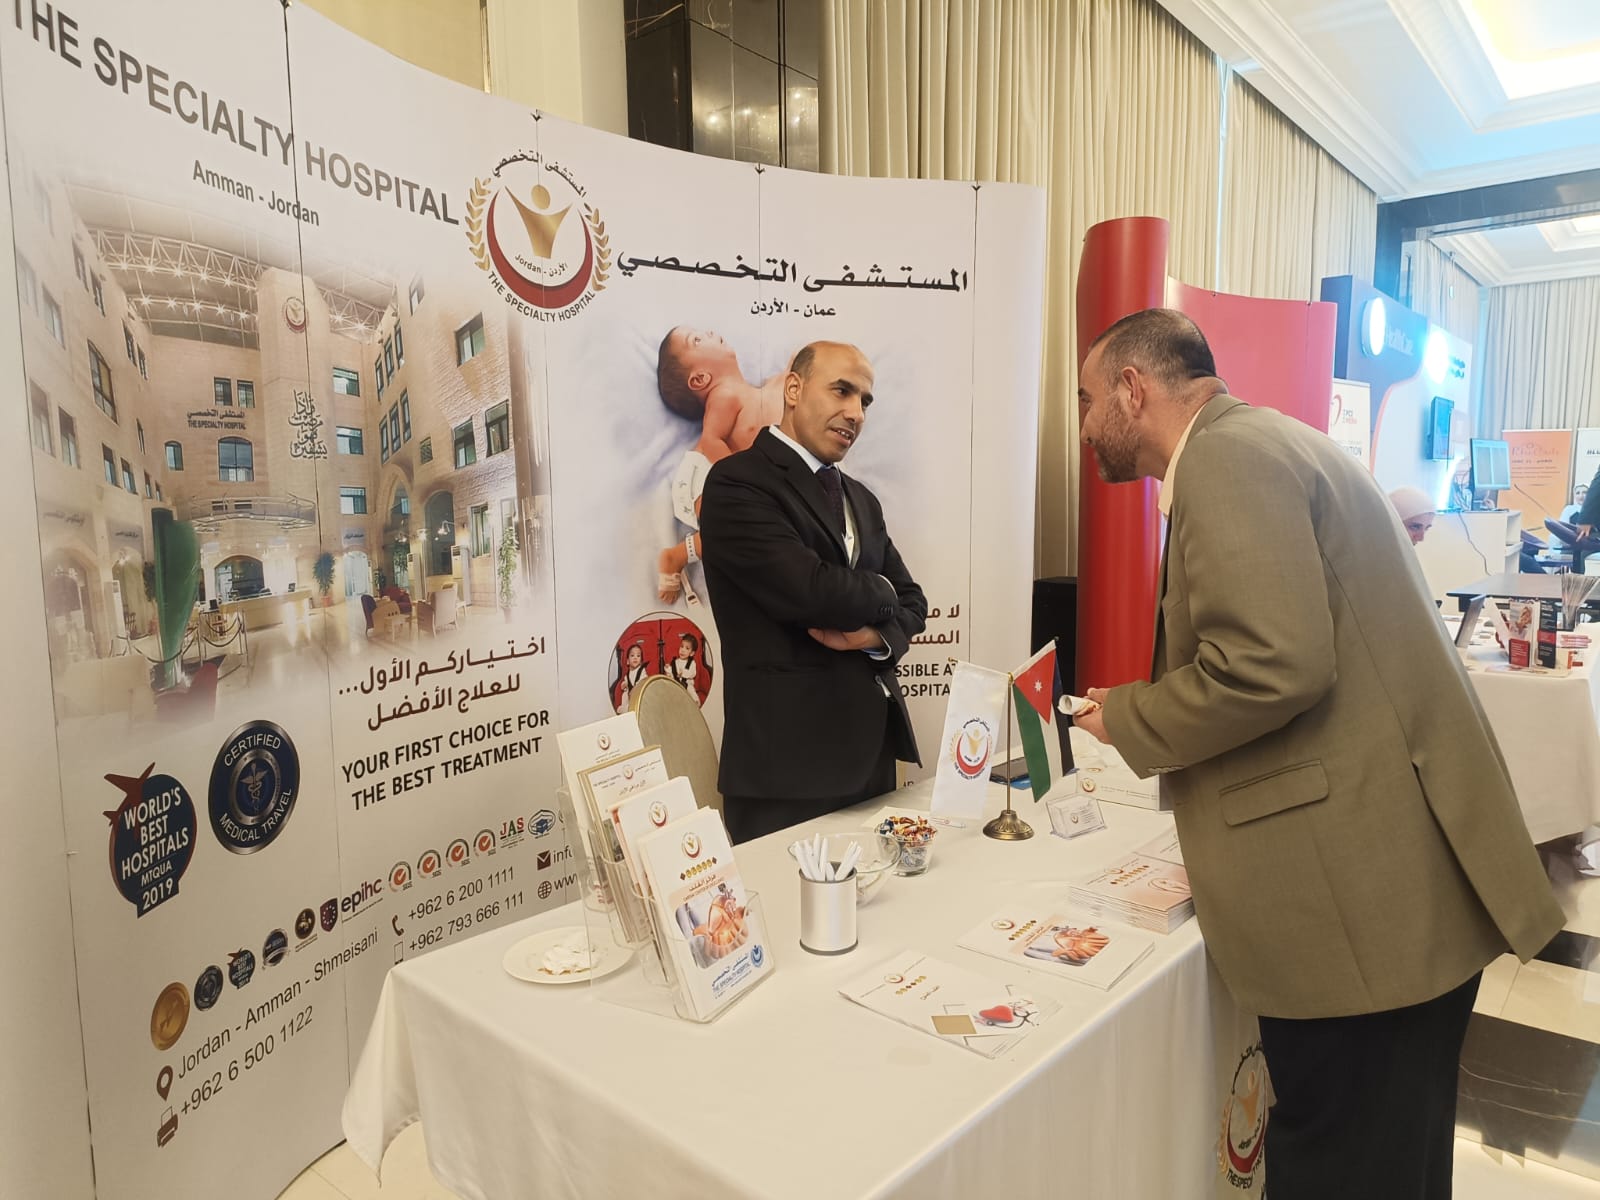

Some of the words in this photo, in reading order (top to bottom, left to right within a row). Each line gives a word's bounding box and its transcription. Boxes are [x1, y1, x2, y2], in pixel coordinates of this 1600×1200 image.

[93, 37, 293, 165] SPECIALTY
[305, 141, 459, 225] HOSPITAL
[193, 160, 254, 202] Amman
[268, 190, 320, 226] Jordan
[515, 254, 542, 273] Jordan
[617, 251, 797, 283] التخصصي
[803, 263, 968, 292] المستشفى
[488, 271, 506, 295] THE
[505, 293, 556, 322] SPECIALTY
[559, 290, 595, 321] HOSPITAL
[803, 302, 836, 317] عمان
[415, 636, 545, 686] اختياركم
[943, 664, 956, 676] A
[367, 685, 452, 731] الأفضل
[458, 673, 521, 713] للعلاج
[224, 733, 281, 767] CERTIFIED
[341, 751, 389, 783] YOUR
[395, 735, 443, 765] FIRST
[449, 718, 512, 749] CHOICE
[518, 710, 550, 731] FOR
[351, 781, 386, 811] THE
[392, 765, 435, 795] BEST
[441, 736, 542, 779] TREATMENT
[124, 786, 182, 830] WORLD'S
[140, 815, 168, 846] BEST
[219, 812, 260, 842] MEDICAL
[261, 788, 292, 833] TRAVEL
[500, 817, 524, 837] JAS
[122, 827, 189, 880] HOSPITALS
[141, 860, 173, 887] MTQUA
[142, 878, 173, 910] 2019
[341, 878, 382, 912] epihc
[408, 895, 442, 921] +962
[446, 890, 455, 906] 6
[459, 878, 483, 901] 200
[487, 866, 514, 889] 1111
[409, 926, 443, 951] +962
[447, 913, 472, 935] 793
[476, 901, 500, 923] 666
[504, 891, 523, 911] 111
[178, 1028, 230, 1079] Jordan
[245, 981, 301, 1031] Amman
[314, 927, 378, 982] Shmeisani
[181, 1072, 223, 1115] +962
[228, 1060, 239, 1081] 6
[245, 1035, 274, 1070] 500
[280, 1005, 313, 1043] 1122
